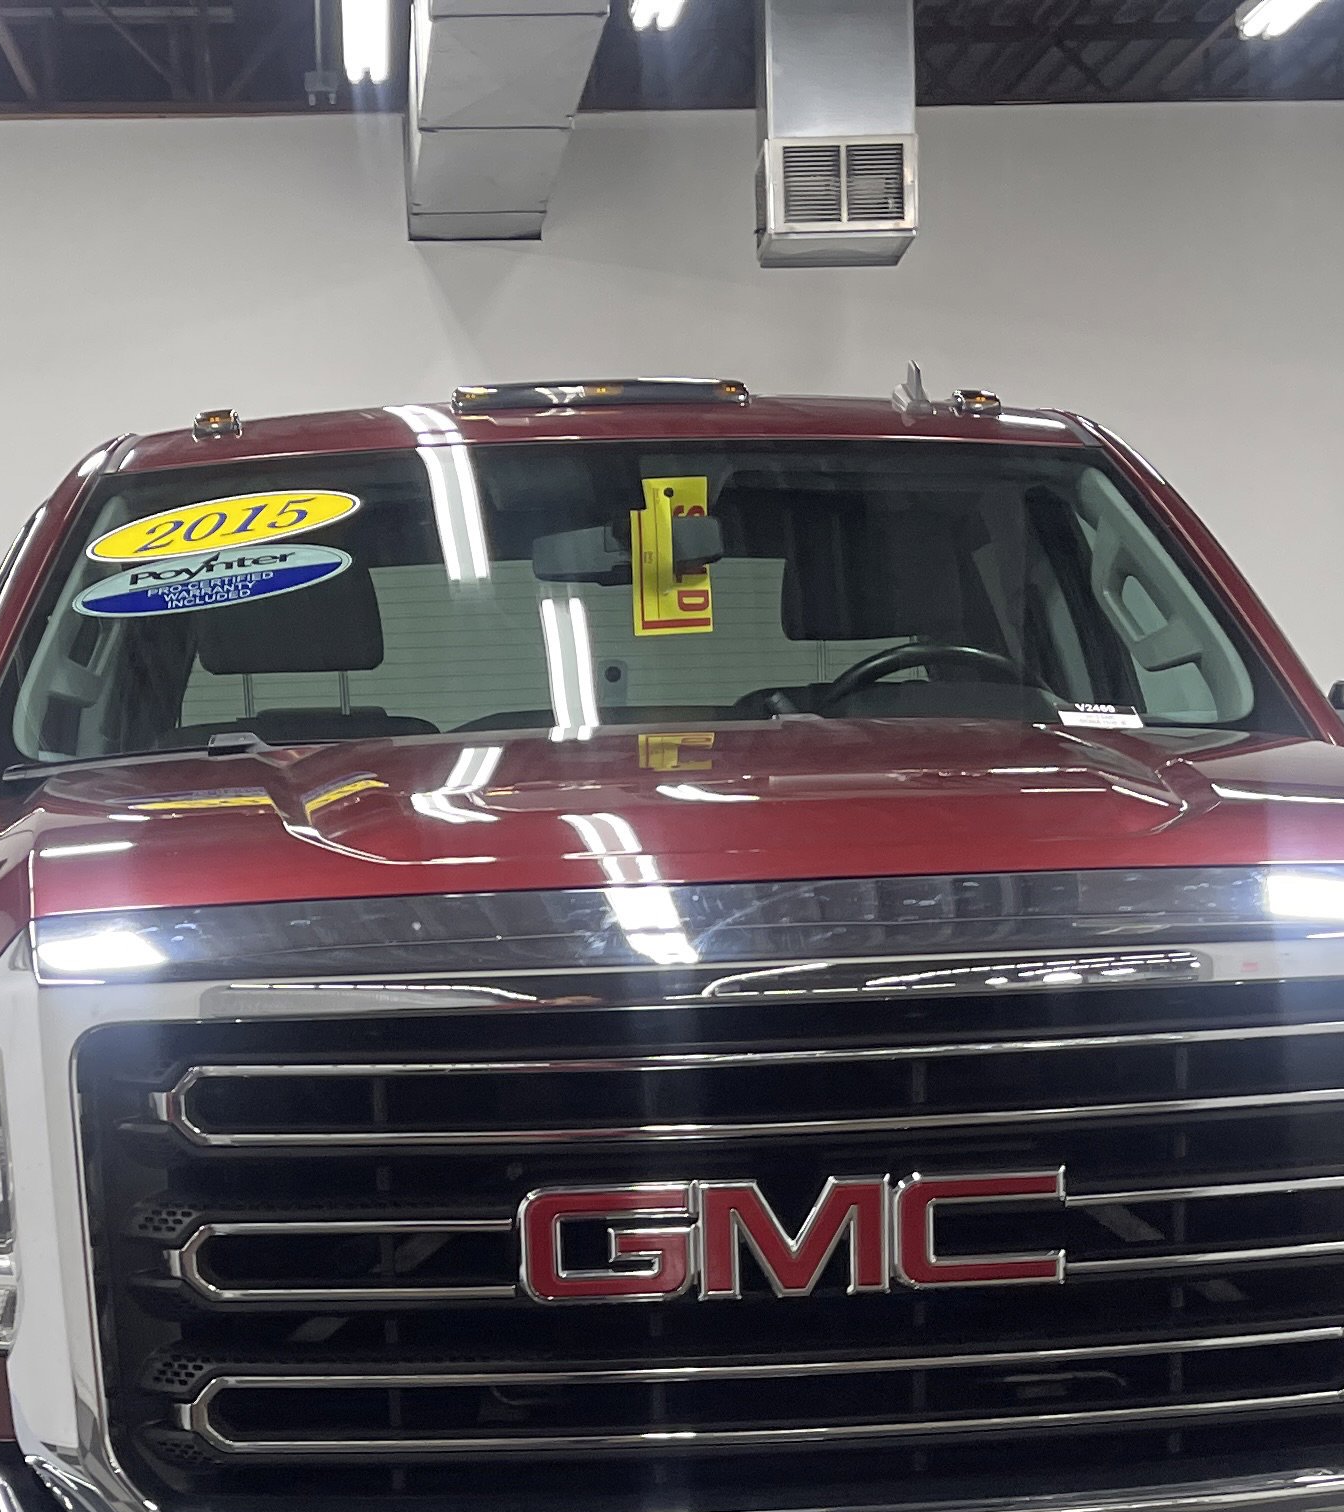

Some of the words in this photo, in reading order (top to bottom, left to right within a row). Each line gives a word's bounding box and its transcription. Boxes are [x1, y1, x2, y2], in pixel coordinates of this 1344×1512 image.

[134, 497, 317, 553] 2015
[129, 552, 296, 586] Poynter
[147, 571, 275, 598] PRO-CERTIFIED
[164, 581, 256, 602] WARRANTY
[167, 589, 252, 609] INCLUDED
[519, 1165, 1066, 1302] GMC
